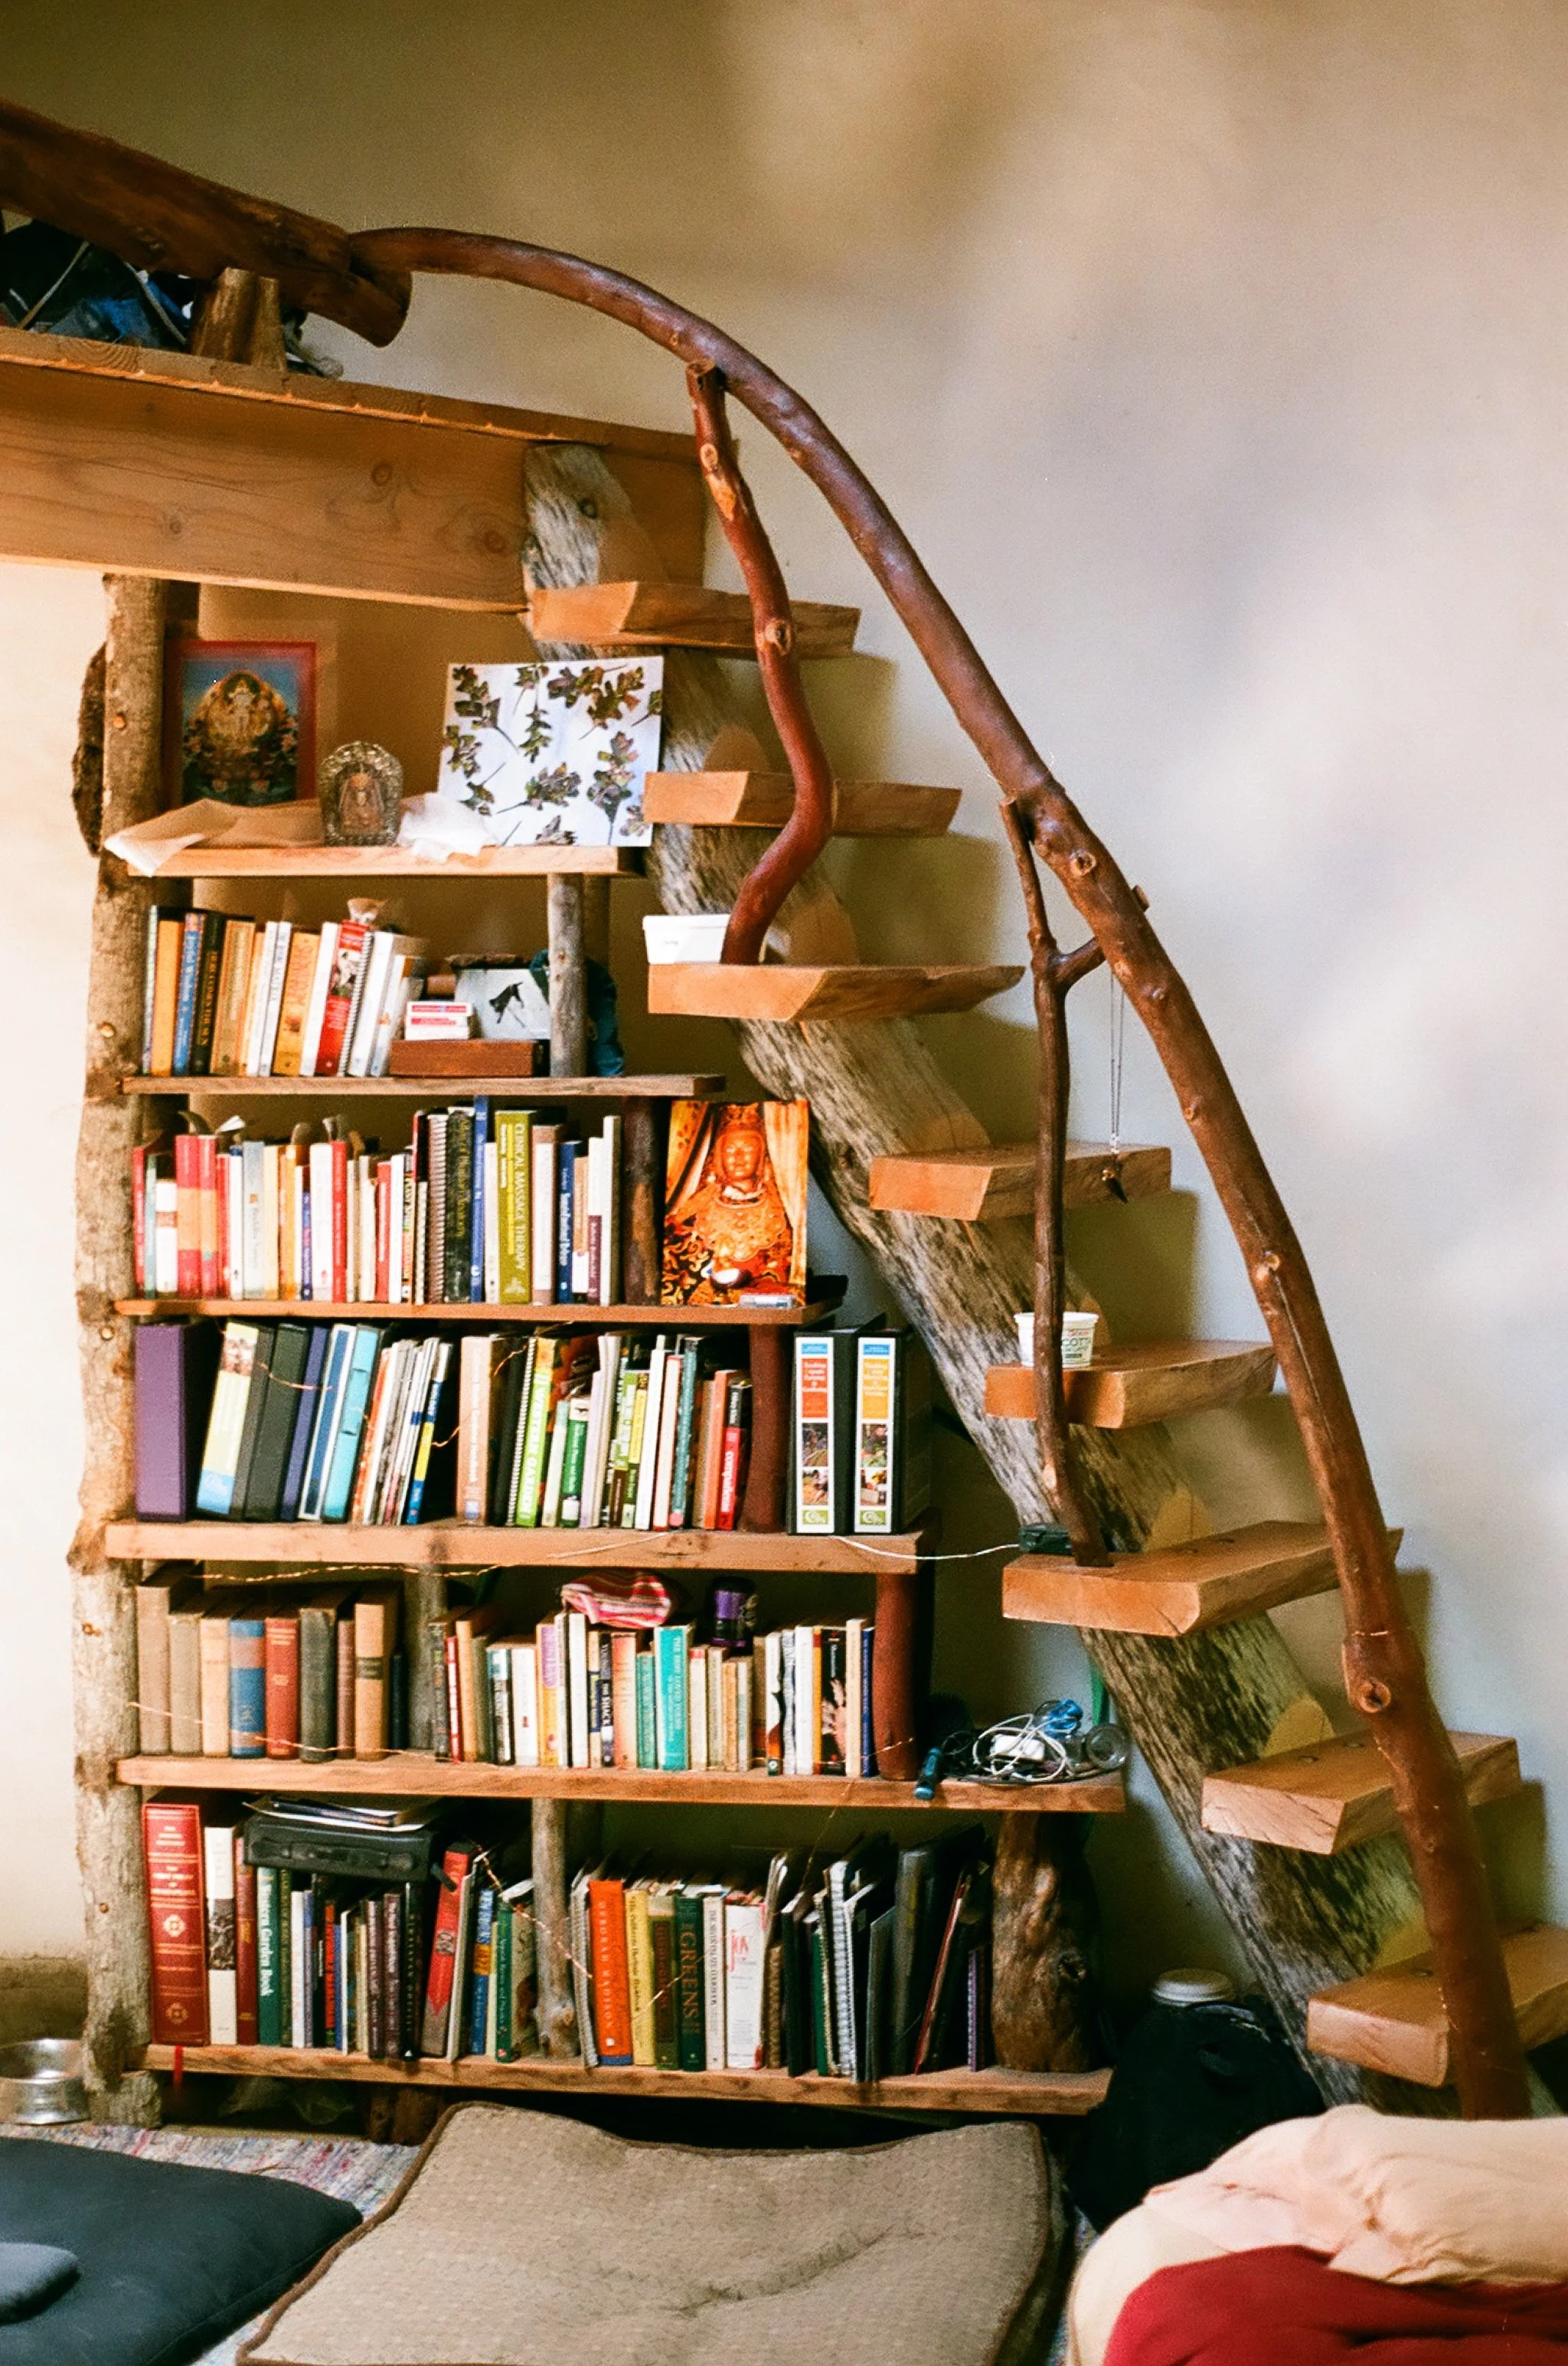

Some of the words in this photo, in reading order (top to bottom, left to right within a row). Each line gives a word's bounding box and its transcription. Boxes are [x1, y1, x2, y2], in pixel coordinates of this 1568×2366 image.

[185, 935, 197, 963] Joyful
[182, 965, 194, 1002] Wisdom
[514, 1123, 524, 1168] CLINICAL
[458, 1155, 469, 1191] Human
[456, 1195, 468, 1237] Anatomy
[514, 1172, 524, 1220] MASSAGE
[514, 1224, 525, 1270] THERAPY
[527, 1387, 546, 1454] WESTERN
[469, 1444, 478, 1482] Handbook
[521, 1456, 538, 1514] GARDEN
[602, 1696, 610, 1725] SHACK
[259, 1884, 271, 1926] Western
[260, 1927, 273, 1966] Garden
[597, 1900, 609, 1962] DEBORAH
[260, 1969, 273, 1996] Book
[681, 1931, 698, 2018] GREENS
[601, 1969, 613, 2028] MADISON
